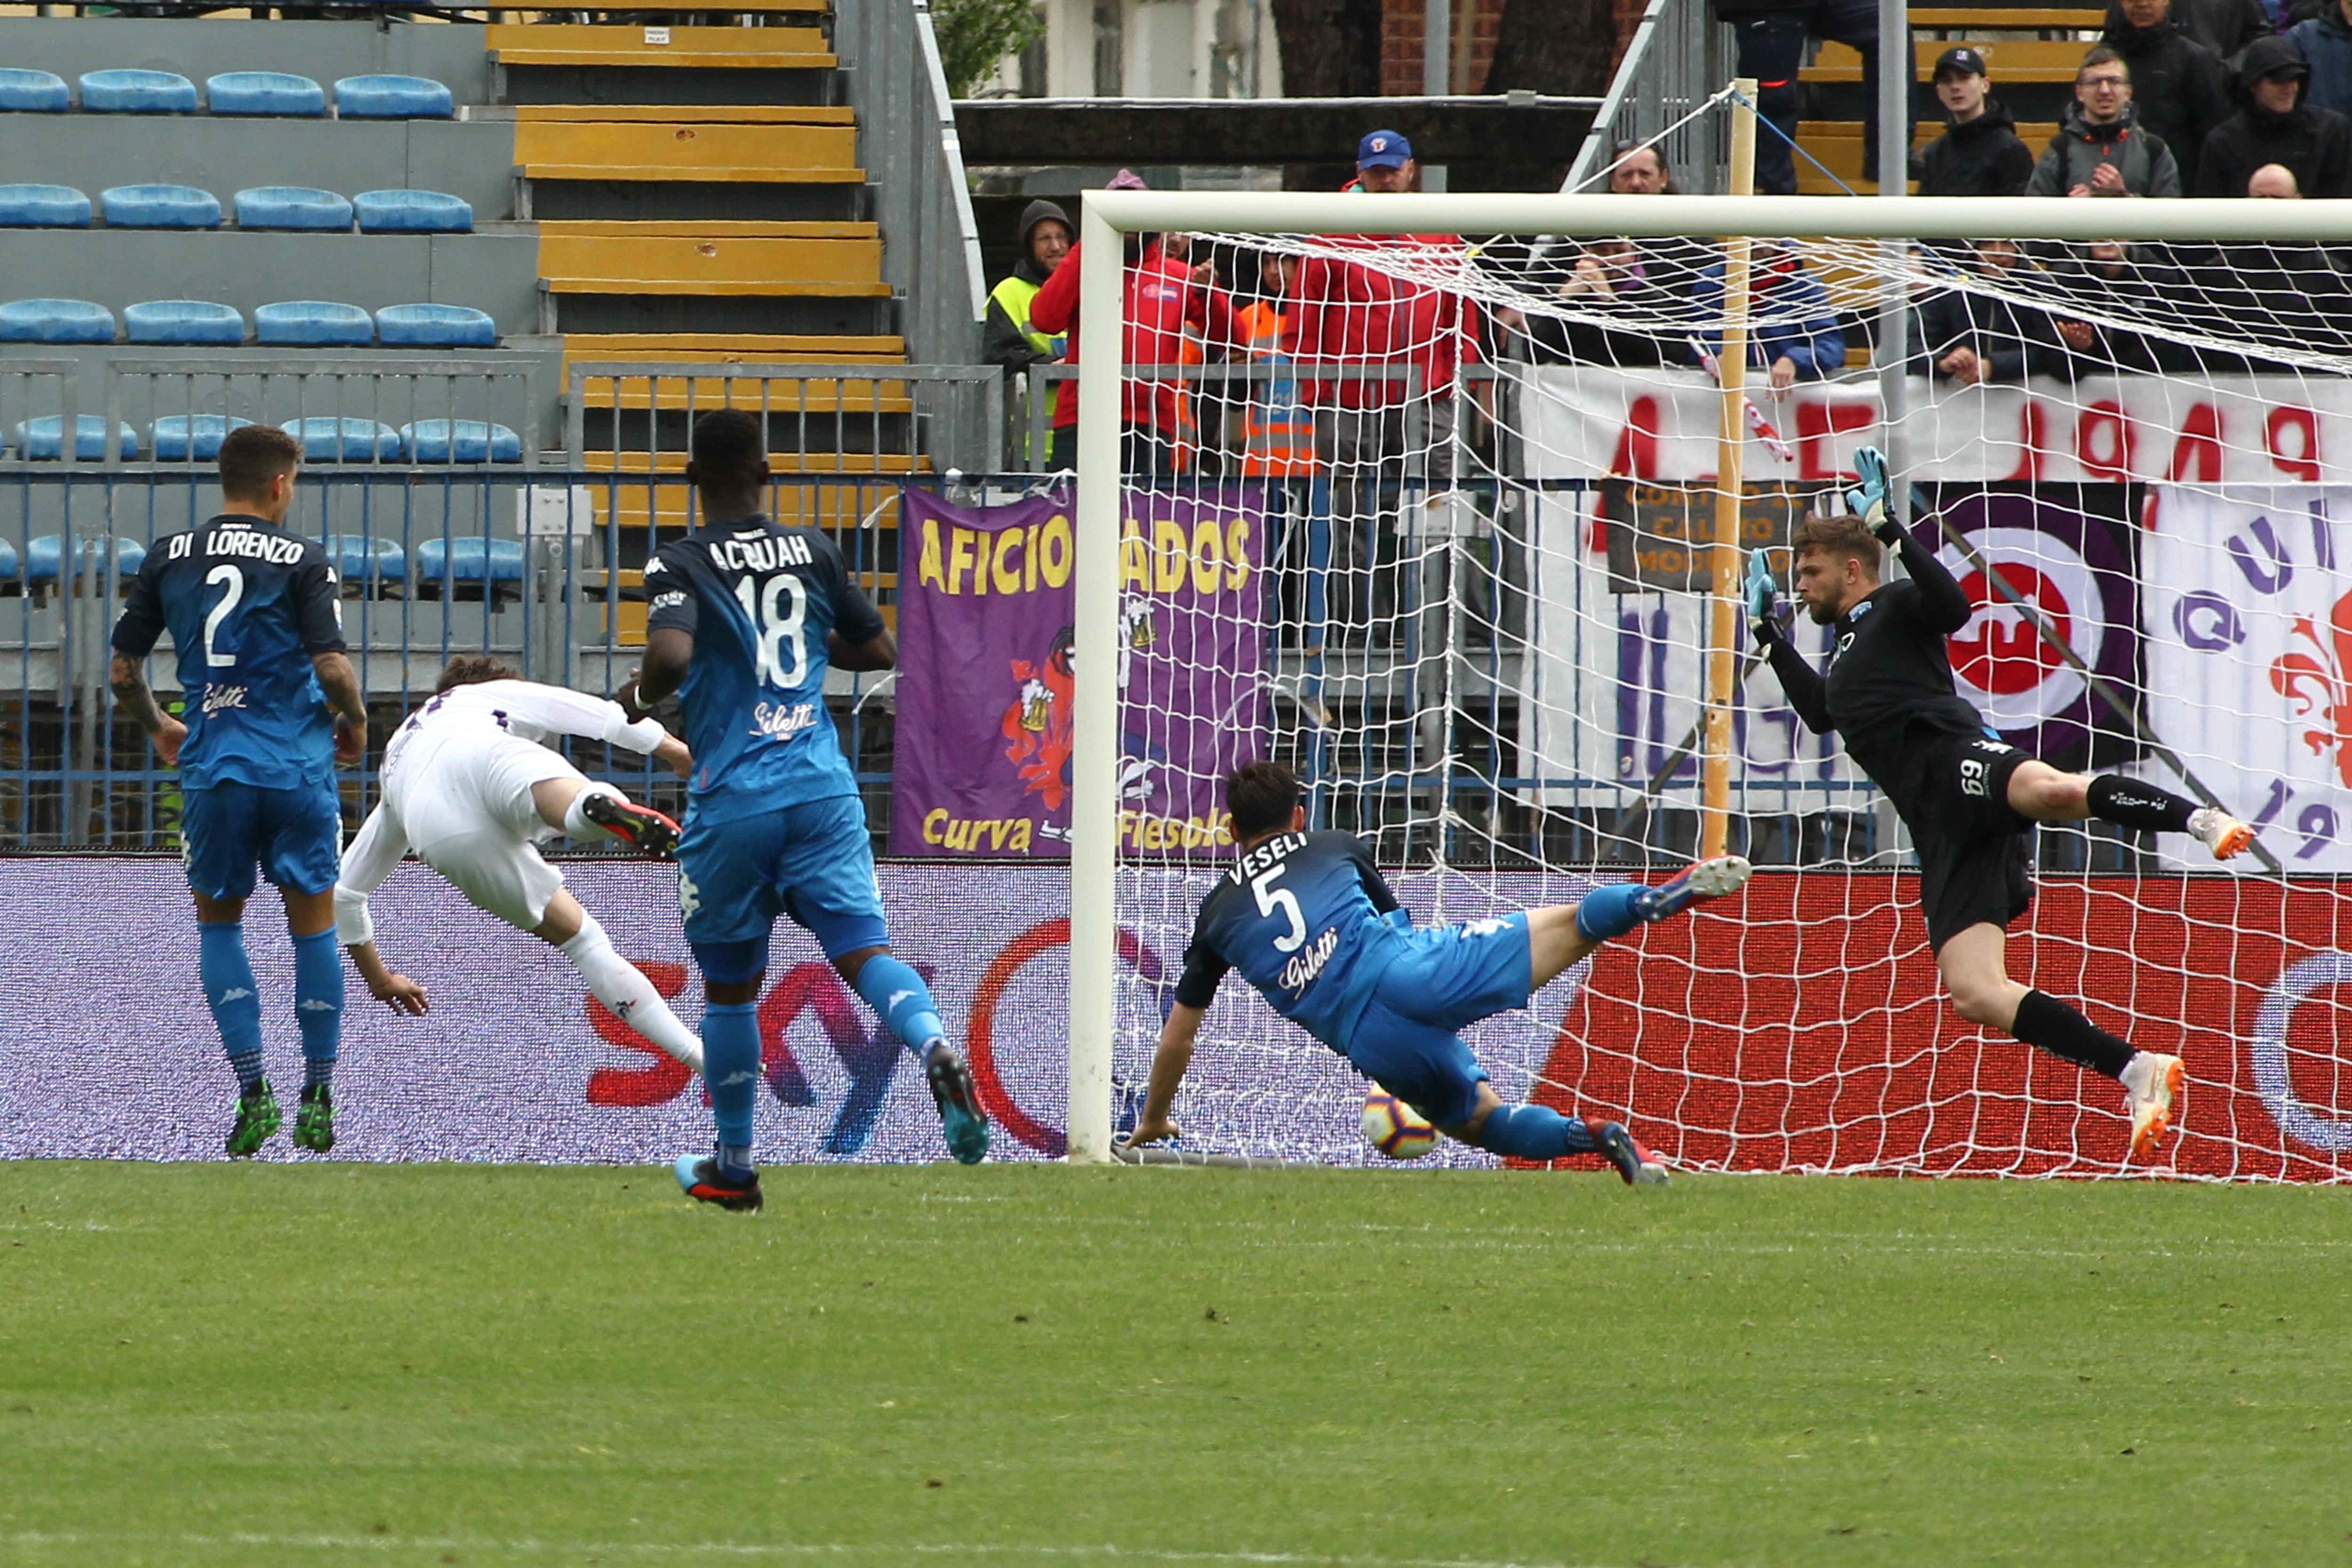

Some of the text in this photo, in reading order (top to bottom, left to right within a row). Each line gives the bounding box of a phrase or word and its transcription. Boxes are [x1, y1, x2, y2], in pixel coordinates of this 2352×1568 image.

[168, 531, 305, 565] DI LORENZO
[709, 534, 813, 572] ACQUAH
[919, 514, 1250, 595] AFICIOADOS
[203, 565, 245, 667] 2
[734, 573, 808, 688] 18
[749, 701, 817, 736] Giletti
[1960, 758, 1985, 796] 69
[923, 807, 1033, 851] Curva
[1228, 832, 1308, 886] VESELI
[1250, 862, 1307, 953] 5
[1279, 926, 1339, 1001] Giletti
